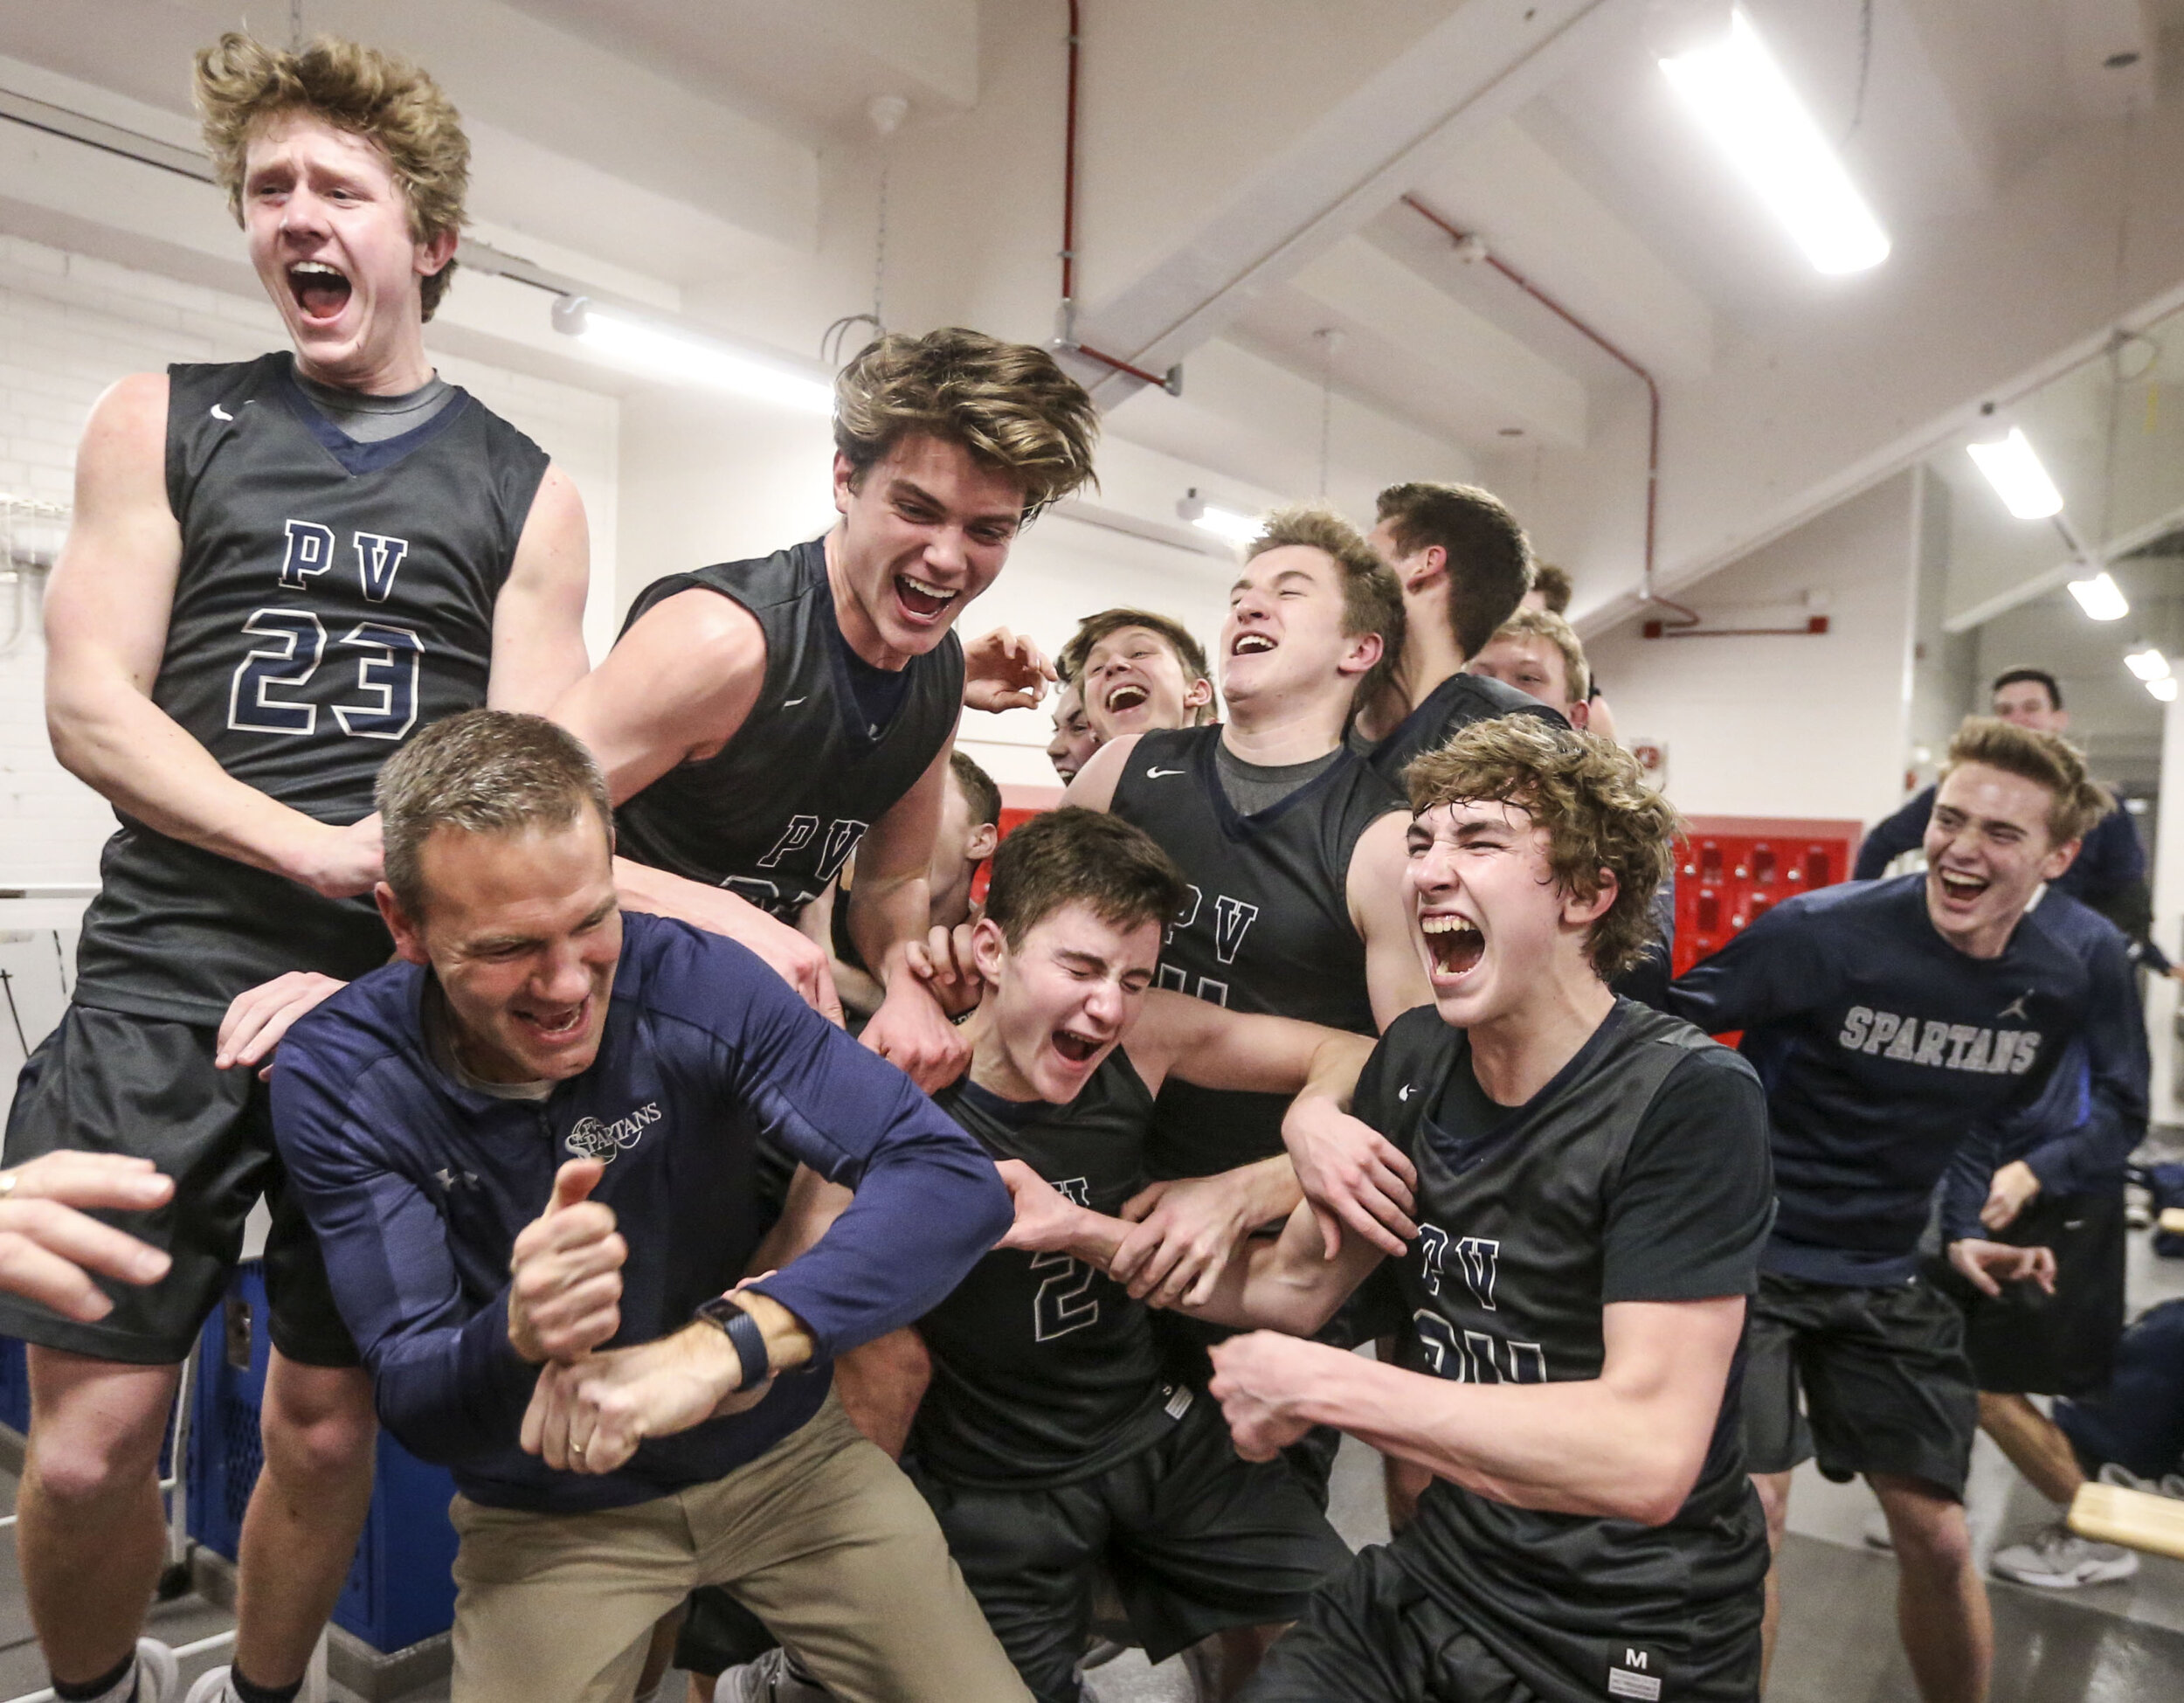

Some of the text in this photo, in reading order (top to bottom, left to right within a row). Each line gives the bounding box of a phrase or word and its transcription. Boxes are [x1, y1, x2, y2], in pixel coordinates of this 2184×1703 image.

[226, 607, 426, 741] 23
[1839, 1005, 2042, 1075] SPARTANS
[564, 1101, 662, 1160] SPARTANS
[1625, 1647, 1648, 1670] M
